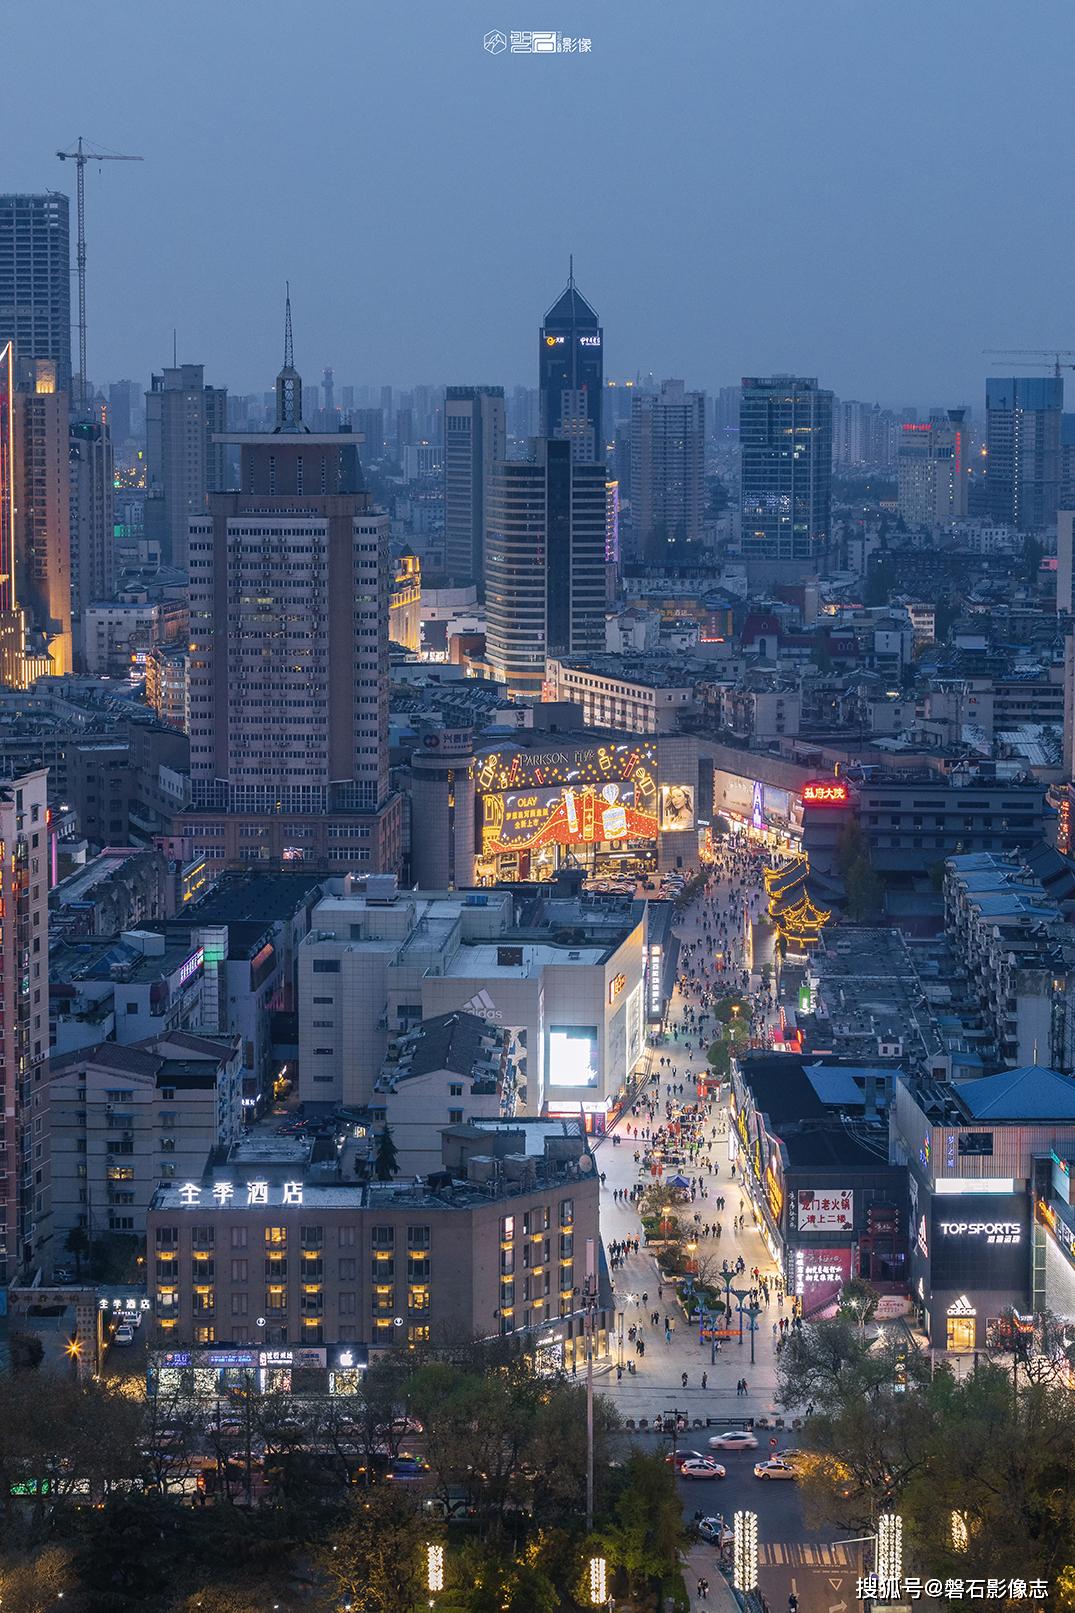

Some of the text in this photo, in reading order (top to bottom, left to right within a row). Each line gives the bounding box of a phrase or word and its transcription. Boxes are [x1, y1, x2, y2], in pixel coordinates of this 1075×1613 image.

[519, 752, 568, 767] PARKSON
[517, 796, 538, 808] OLAY
[178, 1181, 304, 1205] 全季酒店
[801, 1198, 851, 1211] 龙门老火锅
[806, 1214, 847, 1224] 请上二楼
[946, 1307, 977, 1316] adidas
